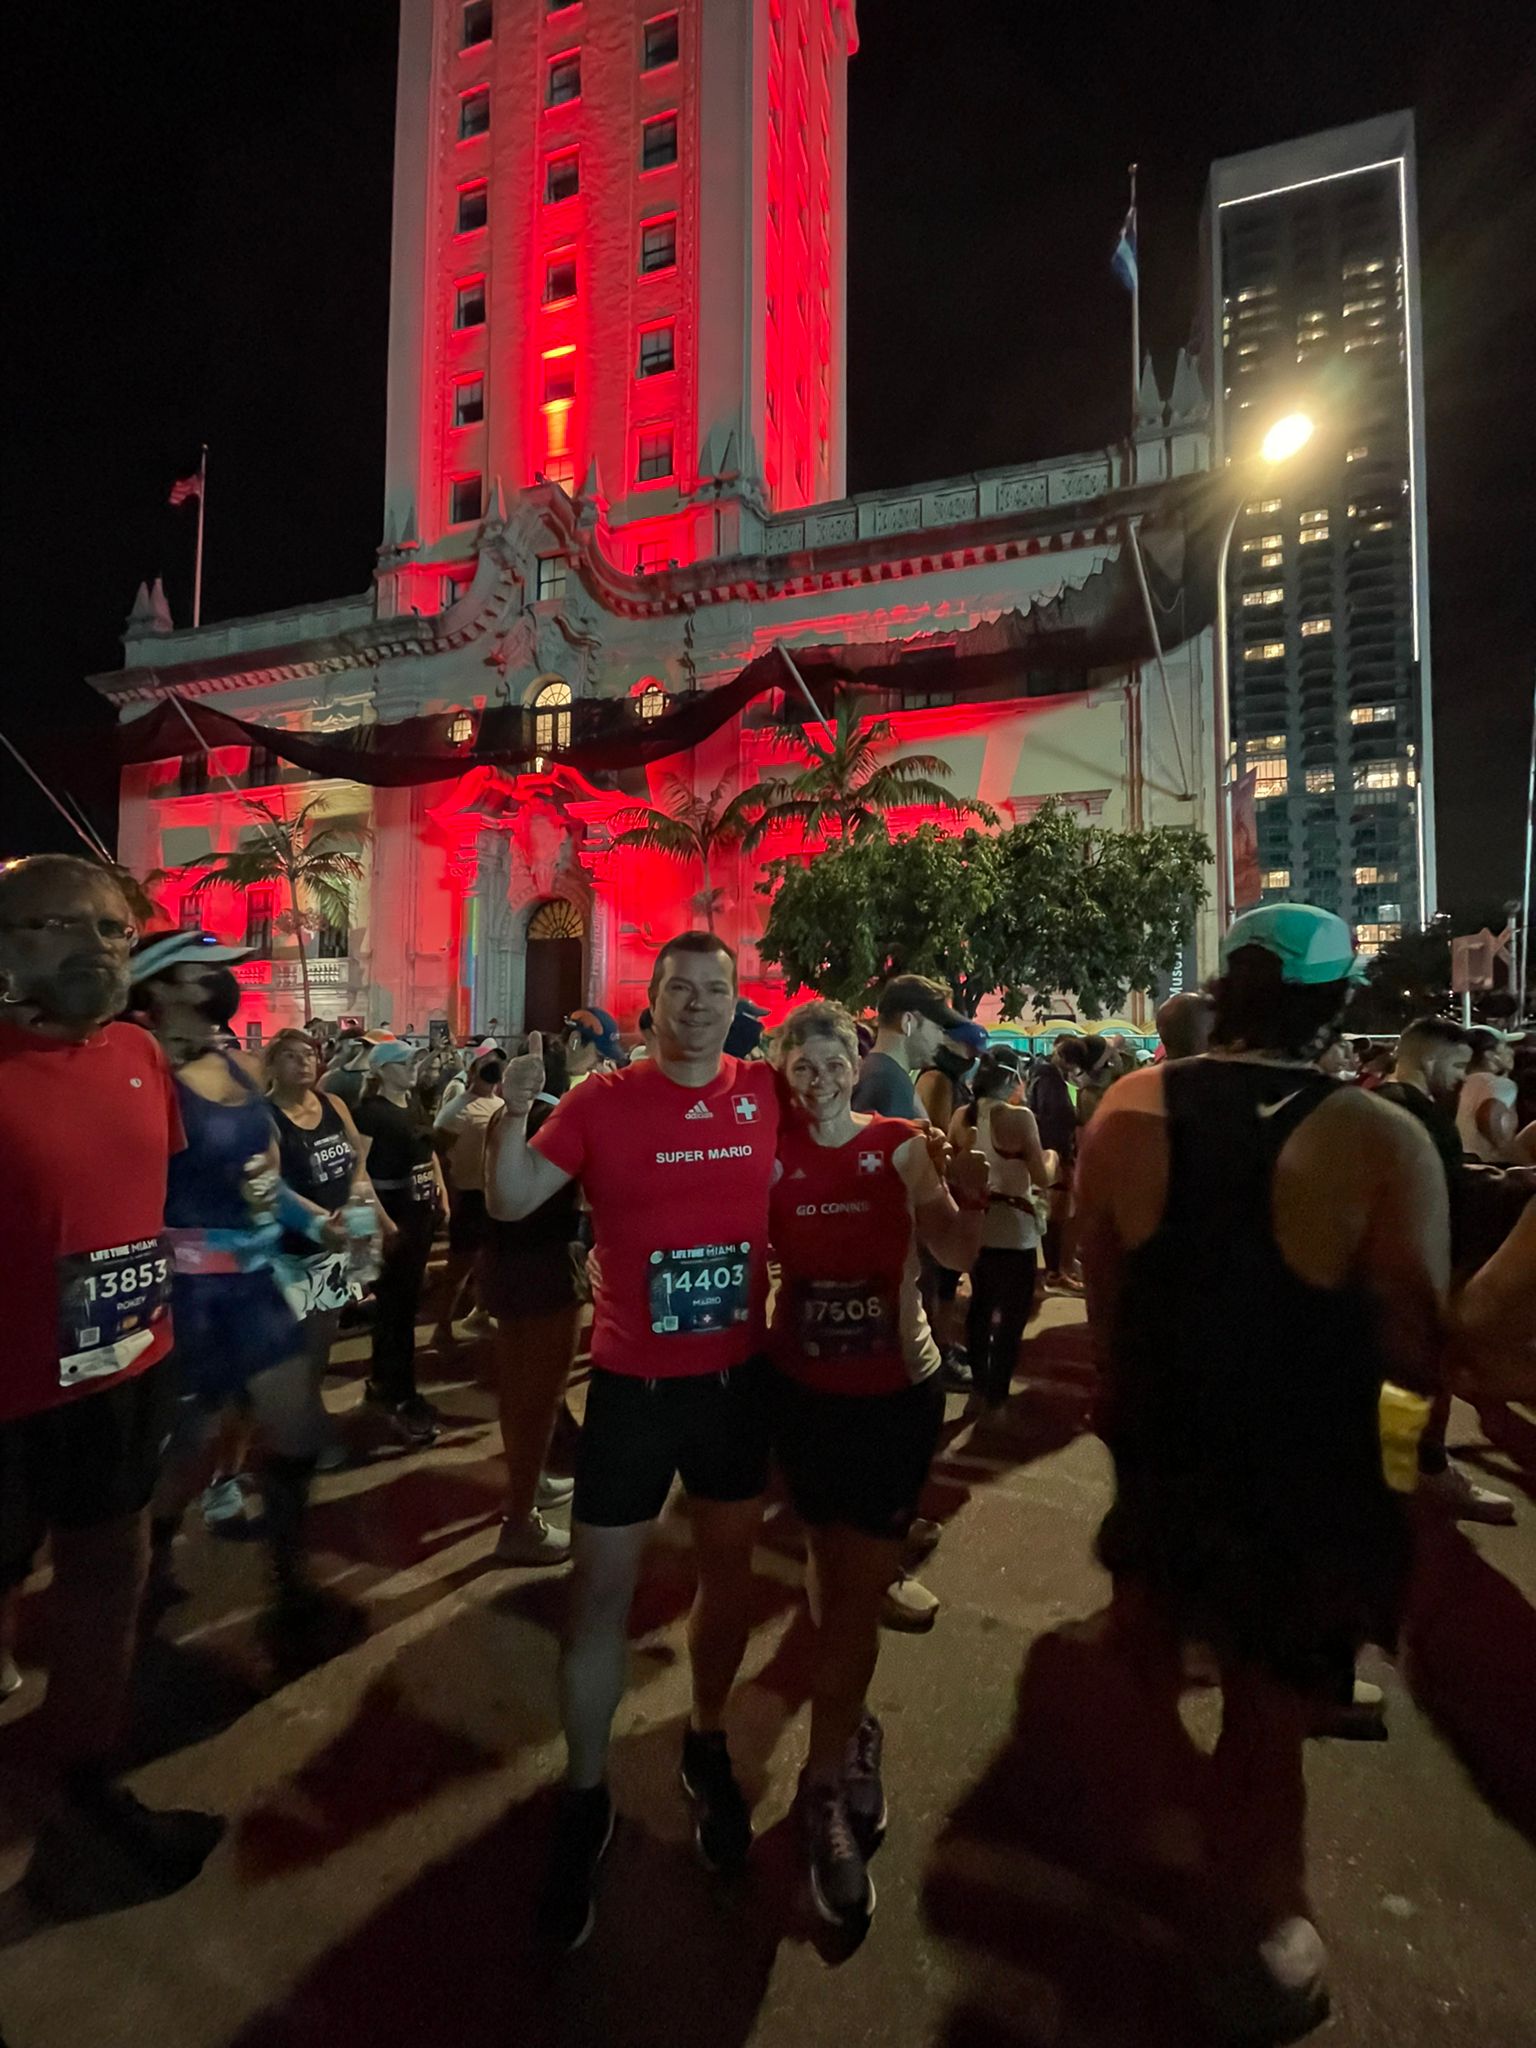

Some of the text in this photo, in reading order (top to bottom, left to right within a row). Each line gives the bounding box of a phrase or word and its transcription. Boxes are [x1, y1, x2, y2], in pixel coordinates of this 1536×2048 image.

[314, 1142, 351, 1163] 18602
[656, 1145, 752, 1164] SUPER MARIO
[412, 1170, 434, 1185] 1860
[796, 1203, 817, 1216] GO
[130, 1238, 158, 1253] MIAMI
[706, 1244, 736, 1257] MIAMI
[84, 1258, 168, 1301] 13853
[662, 1264, 744, 1294] 14403
[693, 1296, 722, 1306] MARIO
